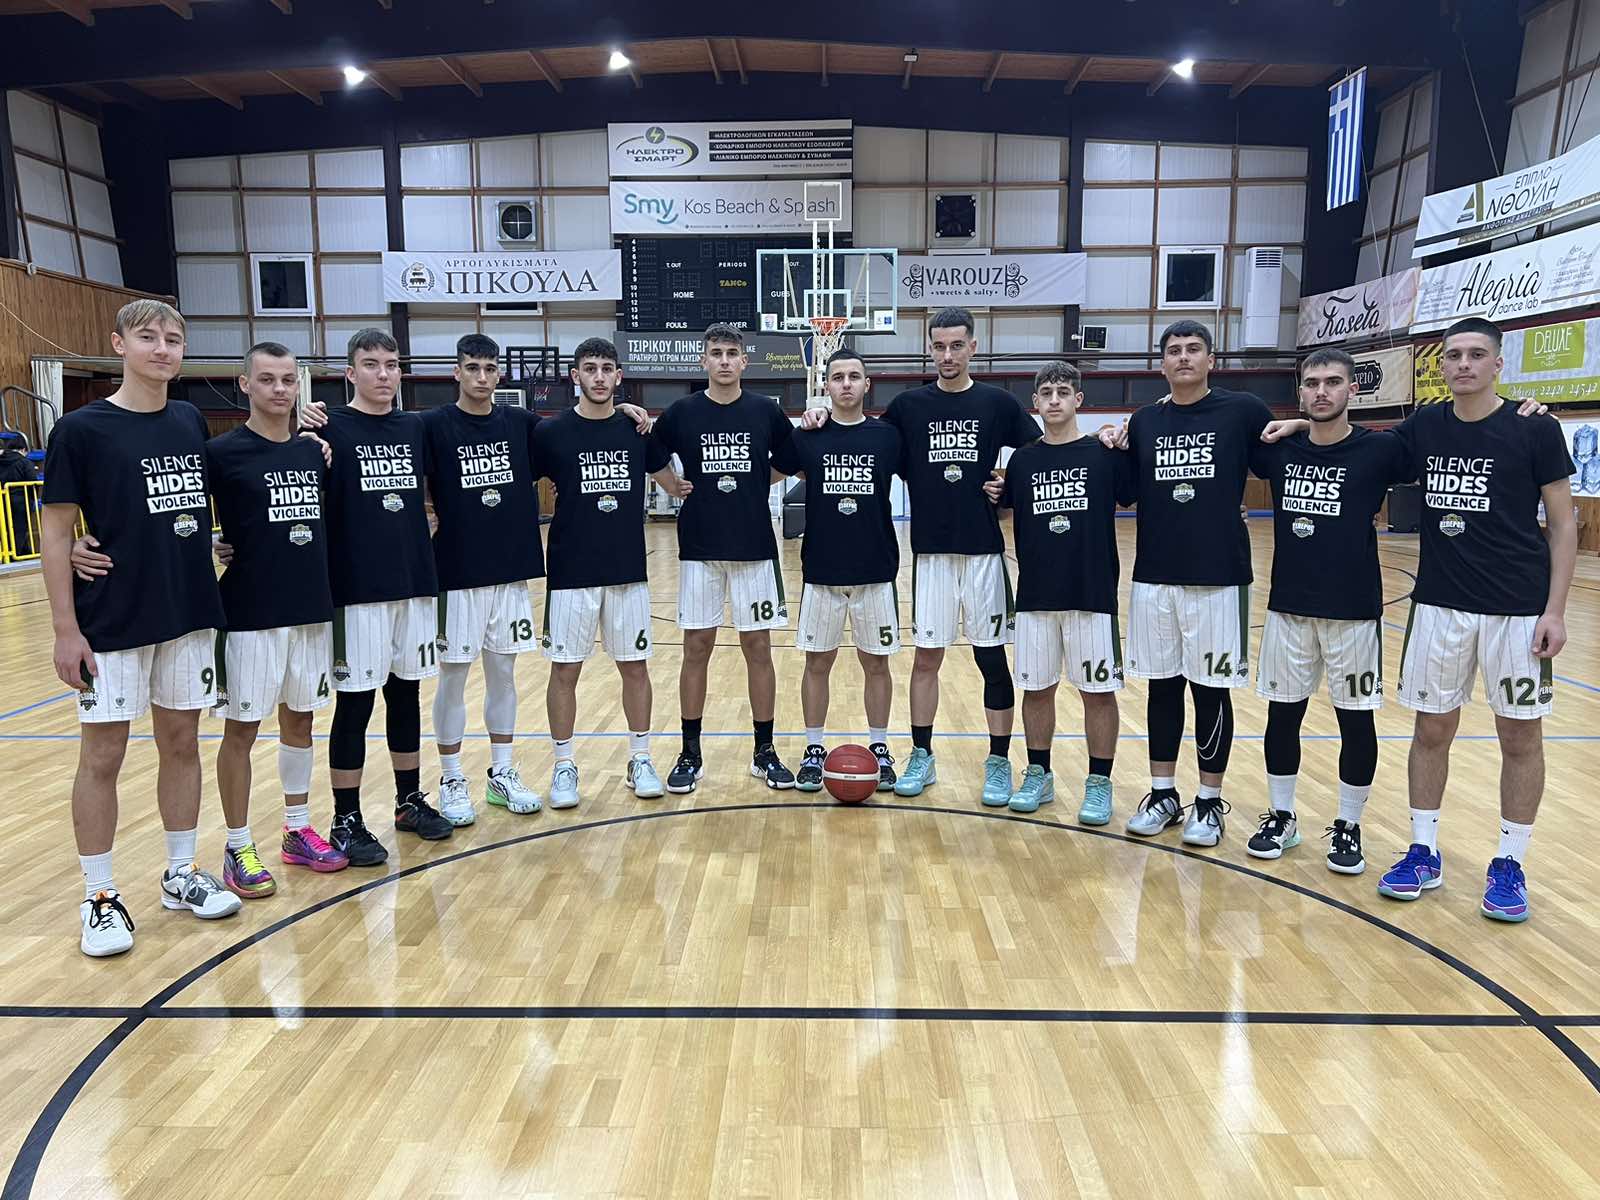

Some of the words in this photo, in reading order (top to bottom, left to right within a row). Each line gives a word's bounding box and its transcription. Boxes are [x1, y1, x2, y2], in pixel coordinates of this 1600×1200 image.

[626, 148, 685, 156] ΗΛΕΚΤΡΟ
[633, 155, 677, 163] ΣΜΑΡΤ
[624, 193, 677, 222] Smy
[684, 198, 711, 214] Kos
[715, 197, 765, 214] Beach
[769, 197, 780, 214] &
[784, 196, 835, 217] Spash
[444, 258, 558, 268] ΑΡΤΟΓΛΥΚΙΣΜΑΤΑ
[445, 269, 599, 295] ΠΙΚΟΥΛΑ
[925, 267, 1004, 286] VAROUZ
[935, 288, 962, 296] sweets
[974, 288, 993, 297] salty
[1456, 259, 1543, 318] Alegria
[1498, 301, 1524, 314] dance
[1525, 296, 1539, 310] lab
[628, 340, 672, 352] ΤΣΙΡΙΚΟΥ
[1534, 327, 1574, 354] DELUXE
[628, 354, 658, 362] ΠΡΑΤΗΡΙΟ
[659, 353, 680, 362] ΥΓΡΩΝ
[928, 420, 979, 434] SILENCE
[700, 432, 751, 446] SILENCE
[930, 433, 977, 449] HIDES
[1155, 432, 1216, 450] SILENCE
[355, 444, 413, 459] SILENCE
[457, 441, 510, 459] SILENCE
[578, 450, 629, 465] SILENCE
[702, 445, 750, 460] HIDES
[931, 451, 976, 461] VIOLENCE
[1156, 447, 1213, 466] HIDES
[141, 454, 203, 475] SILENCE
[360, 459, 414, 476] HIDES
[460, 455, 511, 475] HIDES
[704, 461, 749, 471] VIOLENCE
[823, 454, 875, 467] SILENCE
[1426, 455, 1494, 475] SILENCE
[263, 470, 318, 487] SILENCE
[464, 472, 512, 486] VIOLENCE
[581, 464, 629, 480] HIDES
[824, 467, 872, 481] HIDES
[1031, 467, 1088, 486] SILENCE
[1158, 466, 1212, 478] VIOLENCE
[1284, 463, 1347, 482] SILENCE
[146, 472, 204, 495] HIDES
[364, 477, 415, 488] VIOLENCE
[583, 480, 629, 492] VIOLENCE
[826, 483, 872, 493] VIOLENCE
[1033, 481, 1086, 500] HIDES
[1284, 479, 1341, 500] HIDES
[1426, 472, 1488, 495] HIDES
[152, 494, 205, 510] VIOLENC
[270, 486, 319, 505] HIDES
[1427, 494, 1487, 510] VIOLENCE
[272, 507, 320, 519] VIOLENC
[1035, 499, 1086, 512] VIOLENCE
[1284, 498, 1337, 514] VIOLENCE
[750, 600, 774, 622] 18
[510, 618, 532, 642] 13
[990, 614, 1003, 637] 7
[635, 629, 648, 650] 6
[879, 626, 893, 647] 5
[417, 641, 435, 668] 11
[1082, 659, 1109, 683] 16
[1204, 652, 1232, 677] 14
[201, 667, 215, 695] 9
[317, 672, 329, 698] 4
[1345, 671, 1374, 698] 10
[1499, 677, 1536, 706] 12
